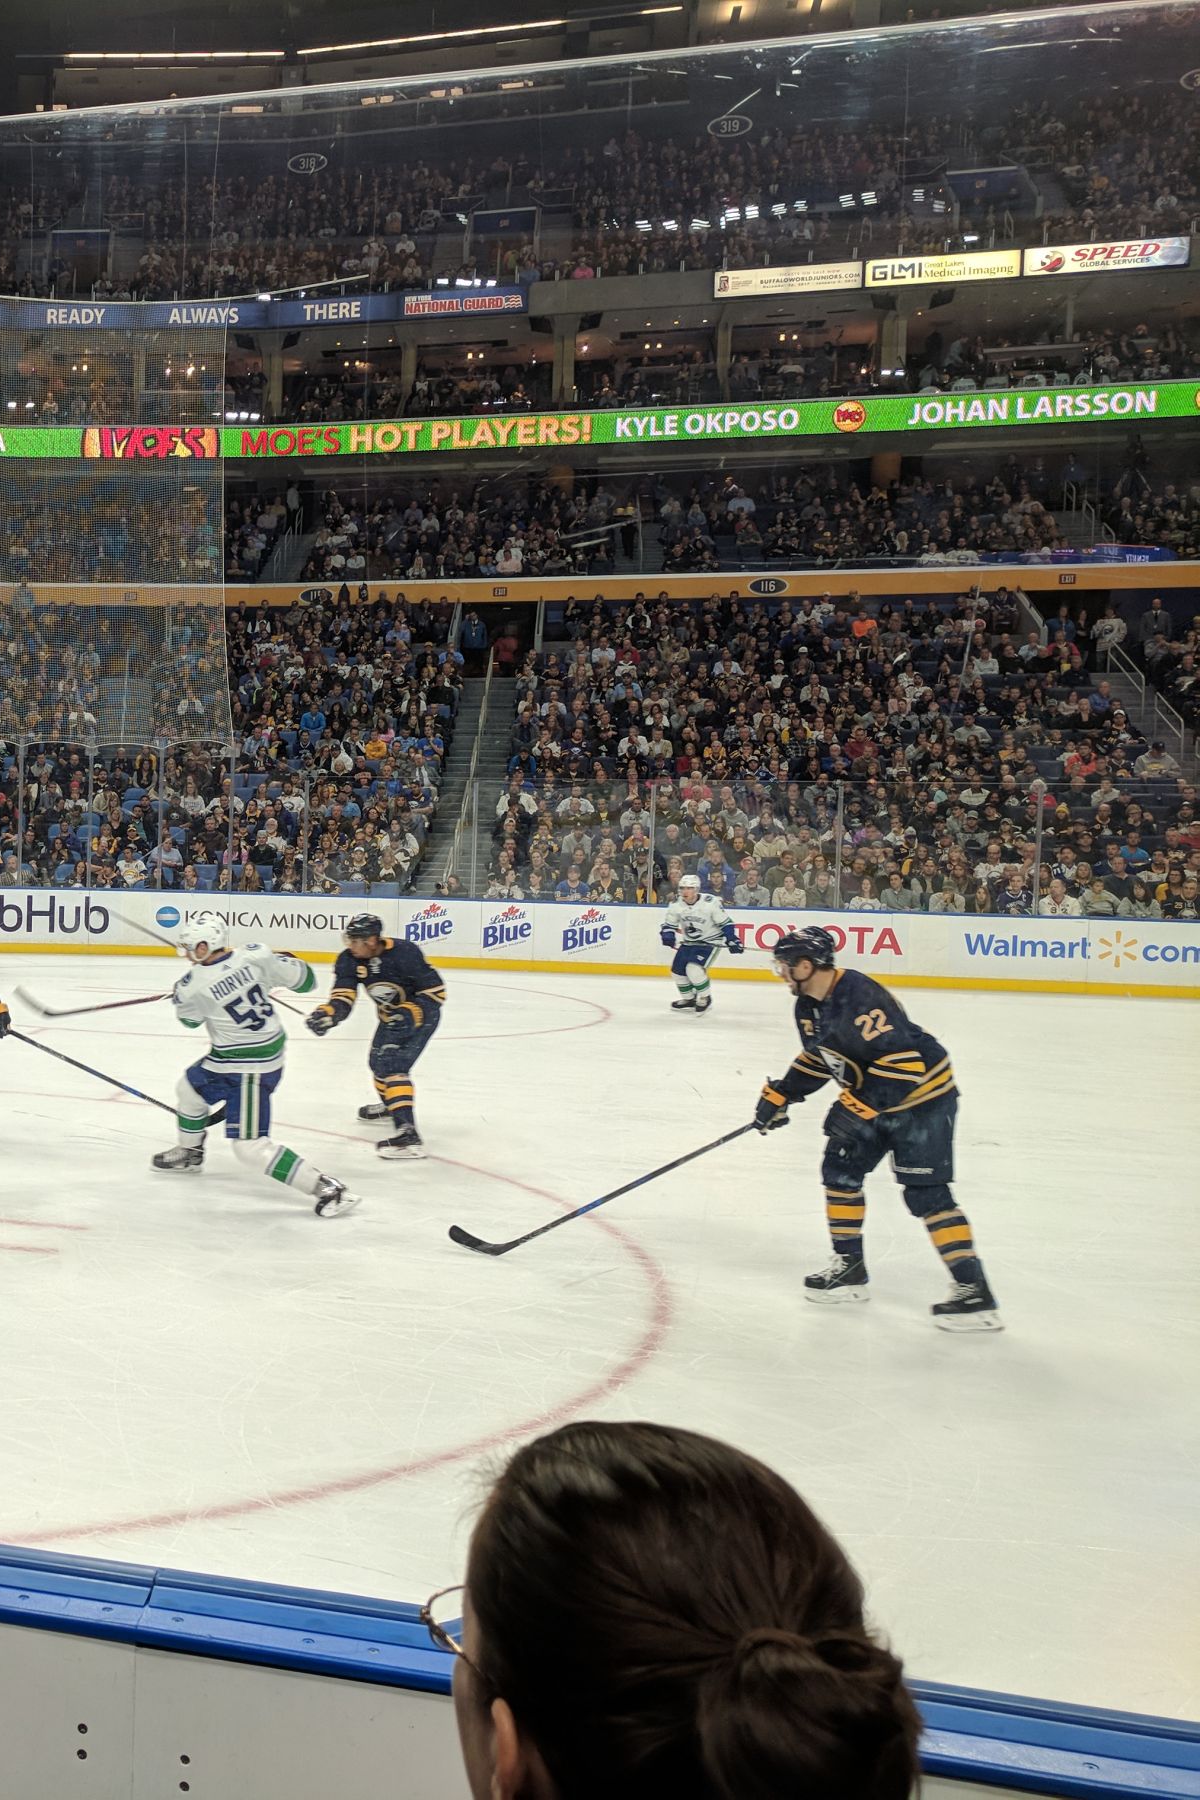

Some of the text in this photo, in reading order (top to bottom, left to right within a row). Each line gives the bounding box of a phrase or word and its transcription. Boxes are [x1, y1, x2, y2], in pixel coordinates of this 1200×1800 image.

[719, 119, 740, 133] 319
[299, 157, 316, 170] 318
[1071, 242, 1162, 262] SPEED
[1079, 256, 1151, 268] GLOBAL SERVICES
[924, 265, 1014, 278] Medical Imaging
[46, 308, 106, 324] READY
[168, 307, 240, 324] ALWAYS
[302, 301, 361, 321] THERE
[404, 296, 505, 315] NATIONAL GUARD
[907, 390, 1158, 425] JOHAN LARSSON
[614, 408, 800, 438] KYLE OKPOSO
[240, 415, 592, 457] MOE'S HOT PLAYERS!
[760, 580, 776, 592] 116
[185, 909, 354, 931] KNICA MINOLT
[411, 908, 448, 922] Labatt
[488, 910, 526, 925] Labatt
[568, 913, 607, 928] Labatt
[405, 919, 453, 942] Blue
[482, 921, 532, 949] Blue
[561, 924, 612, 952] Blue
[965, 933, 1091, 959] Walmart
[209, 964, 256, 1001] HORVAT
[355, 964, 368, 979] 9
[222, 984, 274, 1032] 53
[854, 1008, 895, 1042] 22
